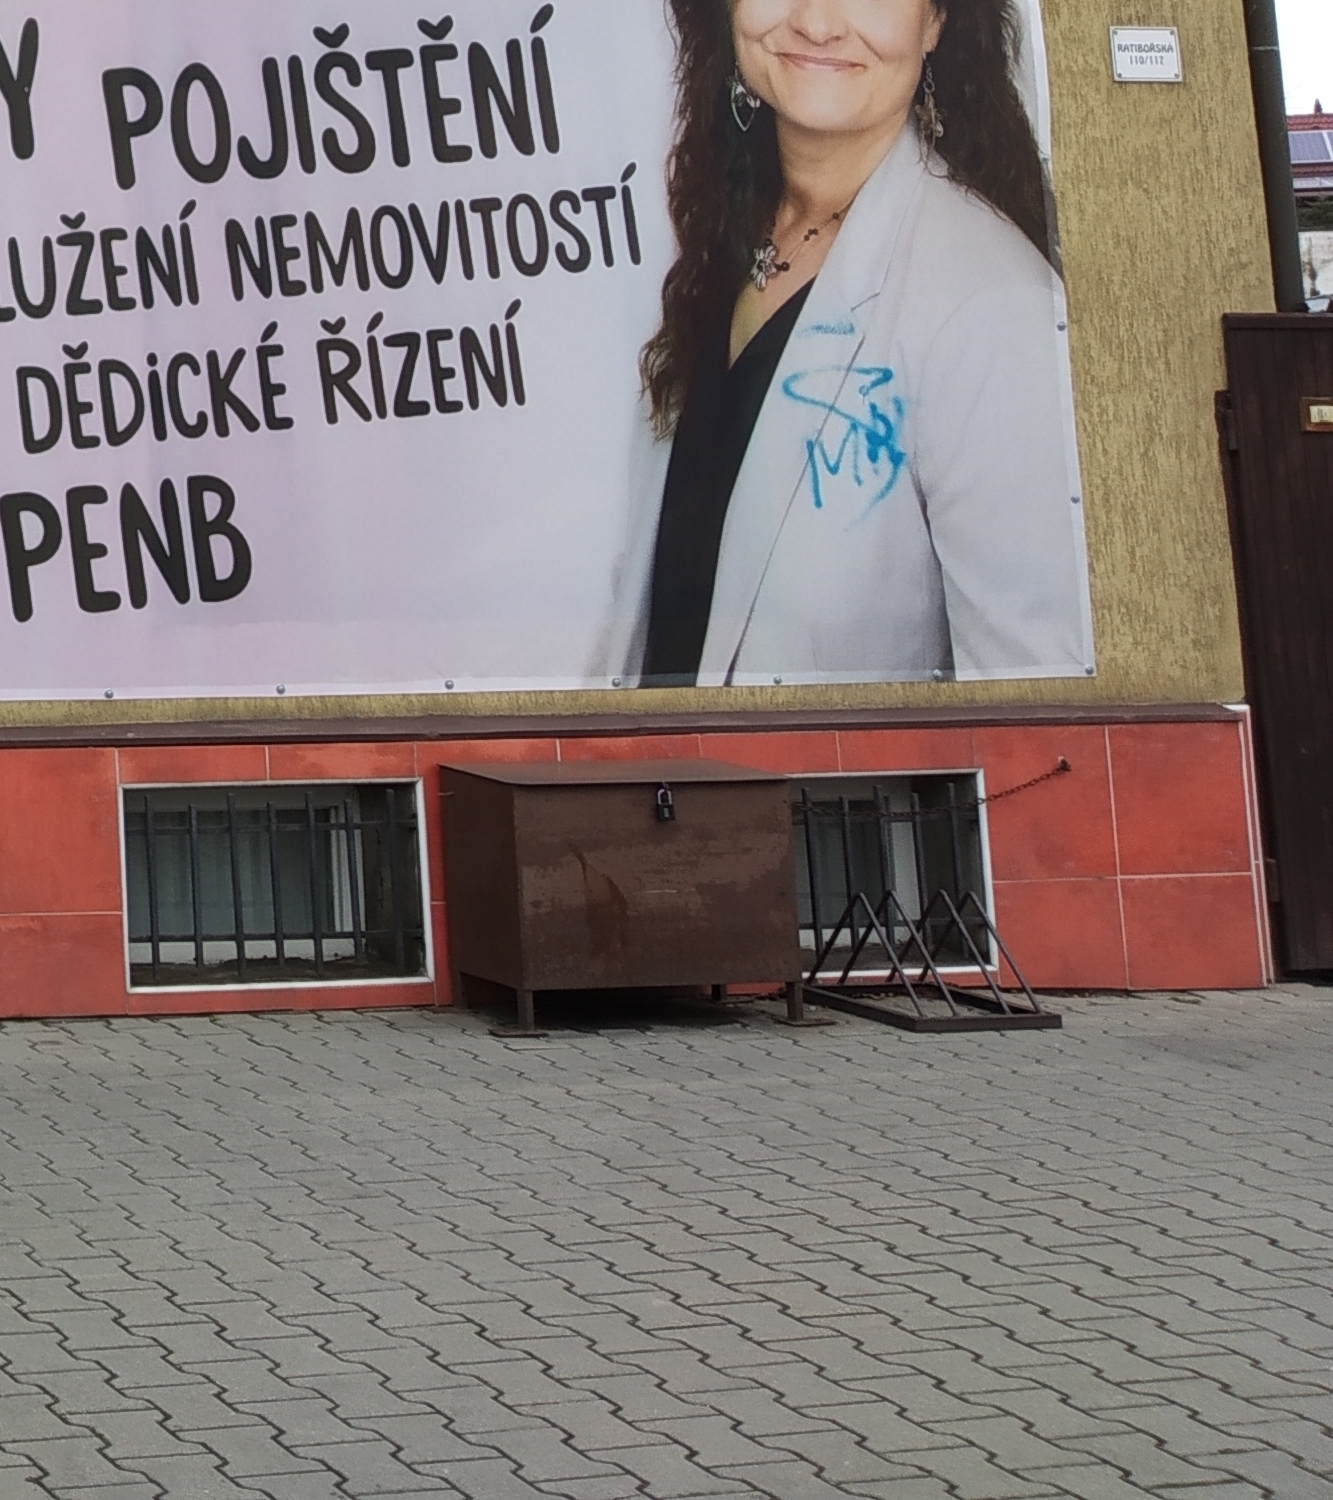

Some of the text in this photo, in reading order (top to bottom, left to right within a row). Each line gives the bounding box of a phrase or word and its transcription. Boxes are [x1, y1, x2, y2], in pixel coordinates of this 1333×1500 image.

[102, 4, 560, 190] POJIŠTĚNÍ
[224, 162, 641, 301] NEMOVITOSTÍ
[316, 298, 526, 425] ŘÍZENÍ
[0, 474, 252, 623] PENB
